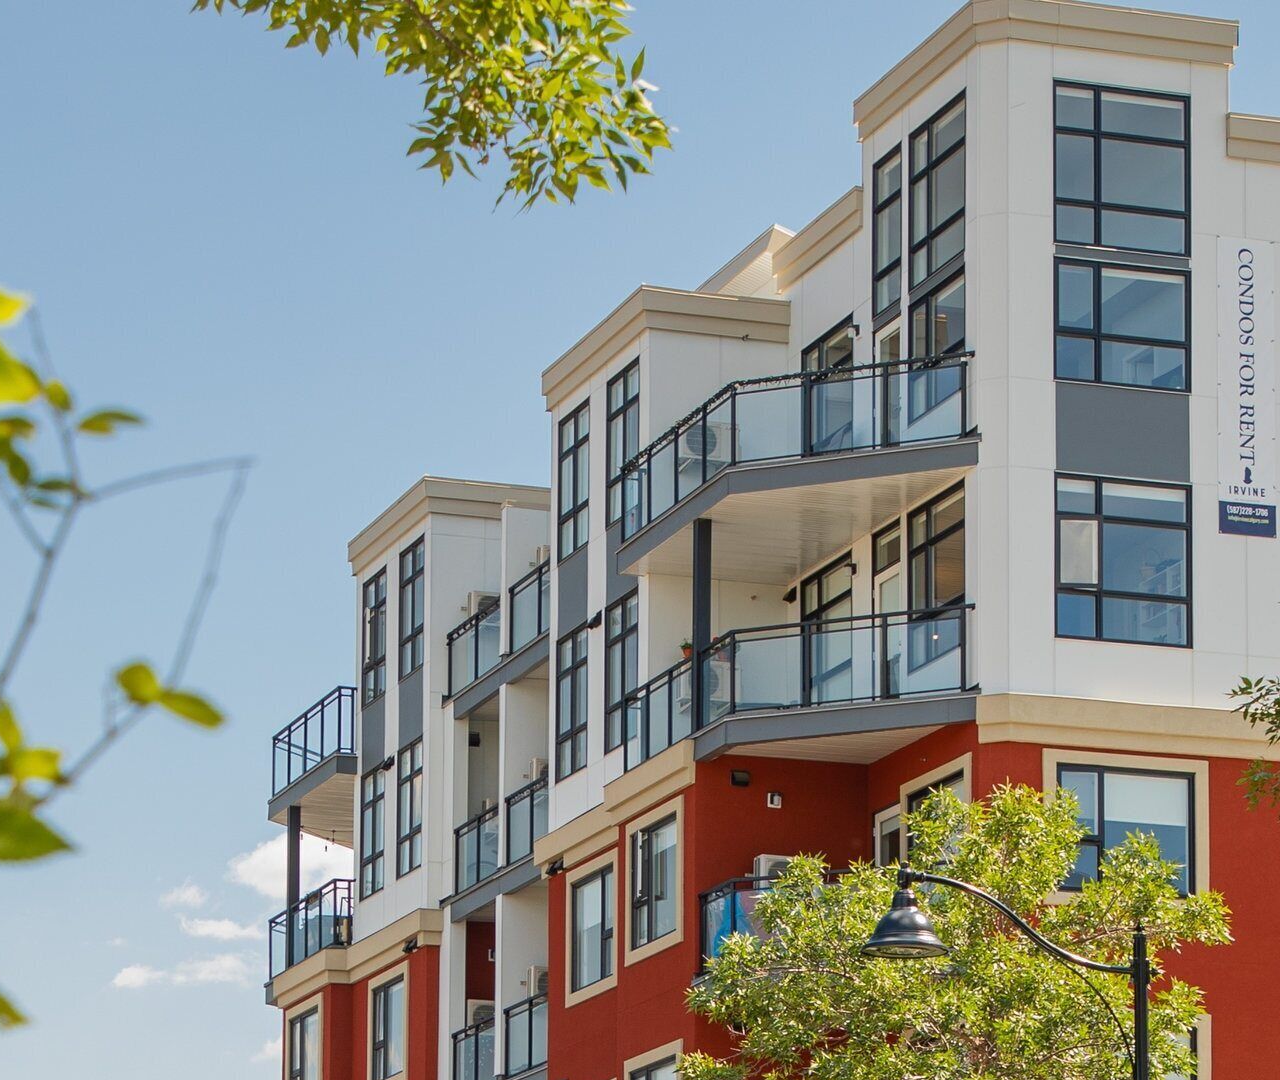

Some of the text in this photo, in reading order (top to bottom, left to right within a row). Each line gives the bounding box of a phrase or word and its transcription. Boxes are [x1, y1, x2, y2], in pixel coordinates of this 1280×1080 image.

[1237, 248, 1256, 466] CONDOS FOR RENT
[1228, 485, 1266, 497] IRVINE
